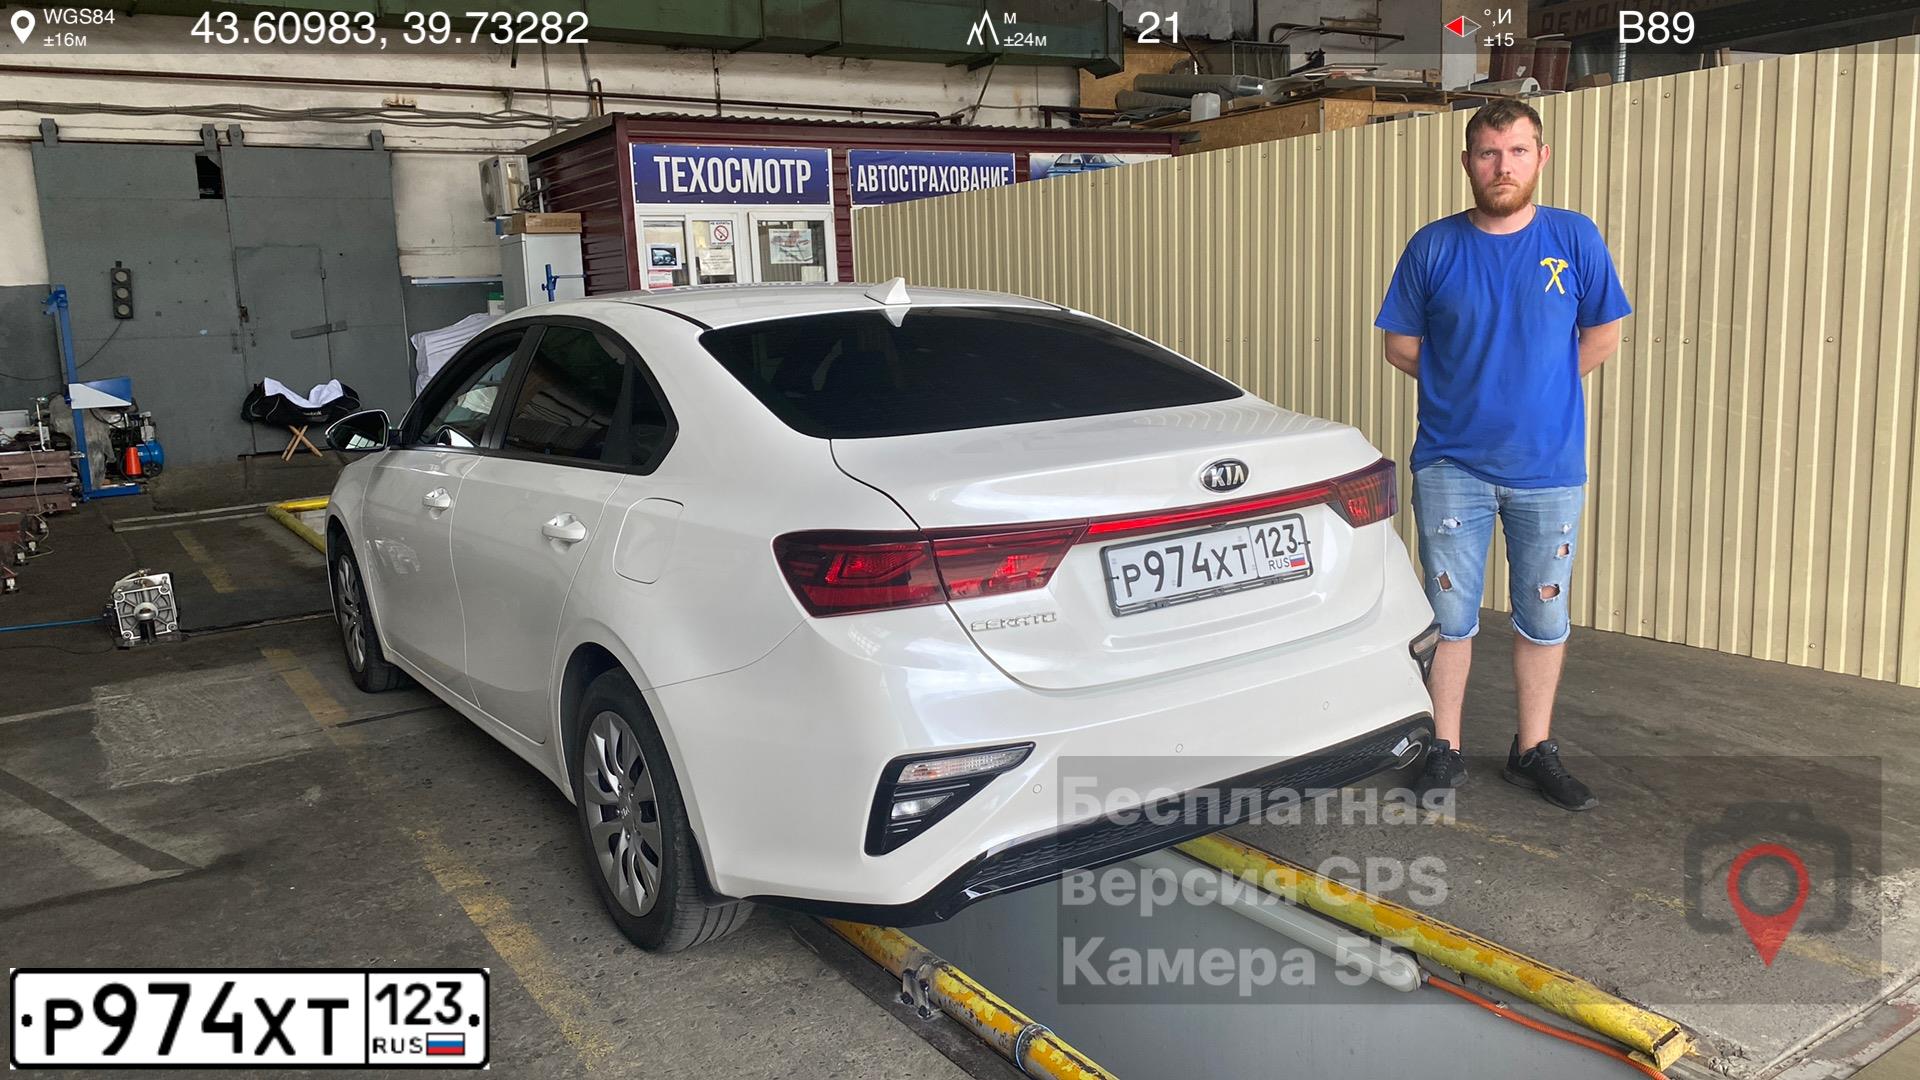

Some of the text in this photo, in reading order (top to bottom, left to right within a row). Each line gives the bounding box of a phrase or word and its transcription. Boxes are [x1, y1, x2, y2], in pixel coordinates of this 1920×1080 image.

[653, 155, 812, 194] ТЕХОСМОТР
[857, 164, 1009, 193] АВТОСТРАХОВАНИЕ
[1210, 464, 1245, 488] KIA
[1122, 524, 1297, 597] Р974ХТ 123
[1269, 557, 1290, 570] RUS
